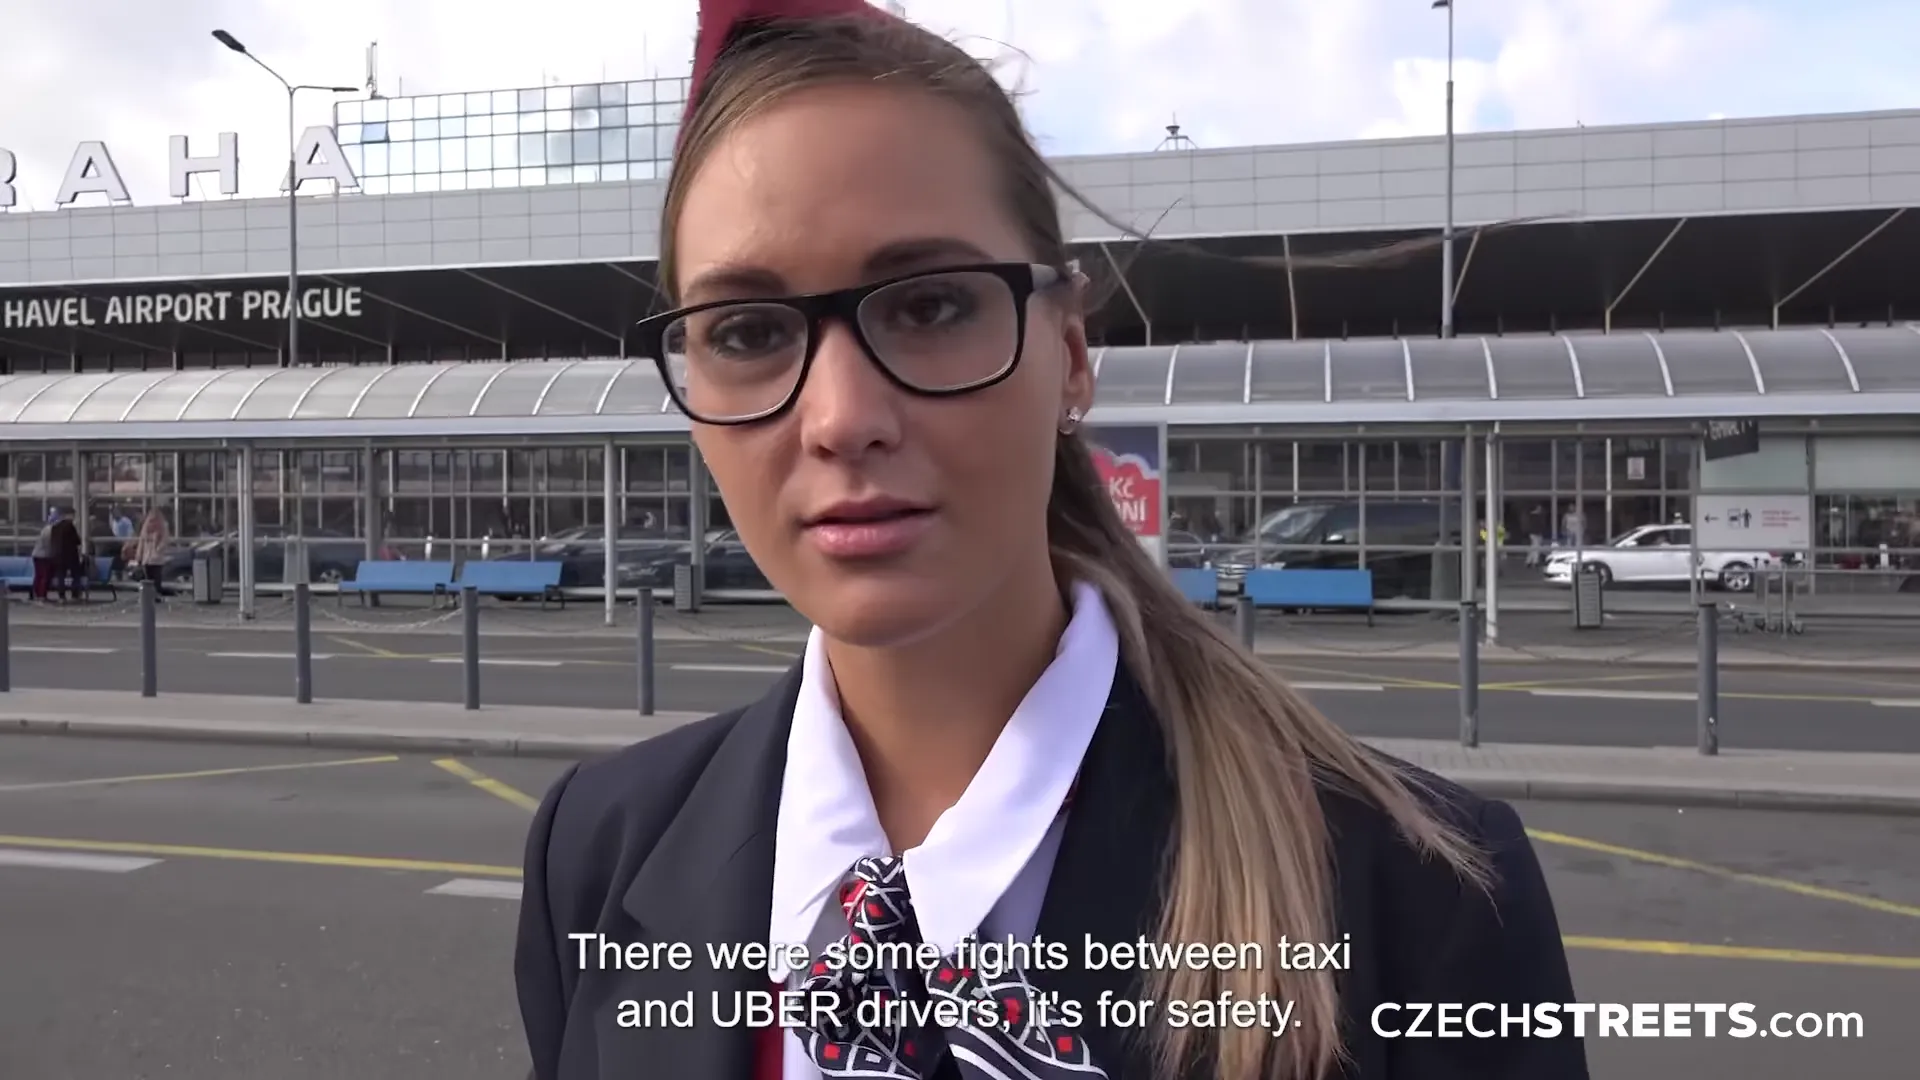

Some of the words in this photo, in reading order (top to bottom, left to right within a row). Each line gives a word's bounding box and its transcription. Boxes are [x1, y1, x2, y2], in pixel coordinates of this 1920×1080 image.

[0, 125, 362, 207] AHA
[5, 298, 95, 328] HAVEL
[104, 291, 232, 325] AIRPORT
[243, 286, 362, 321] PRAGUE
